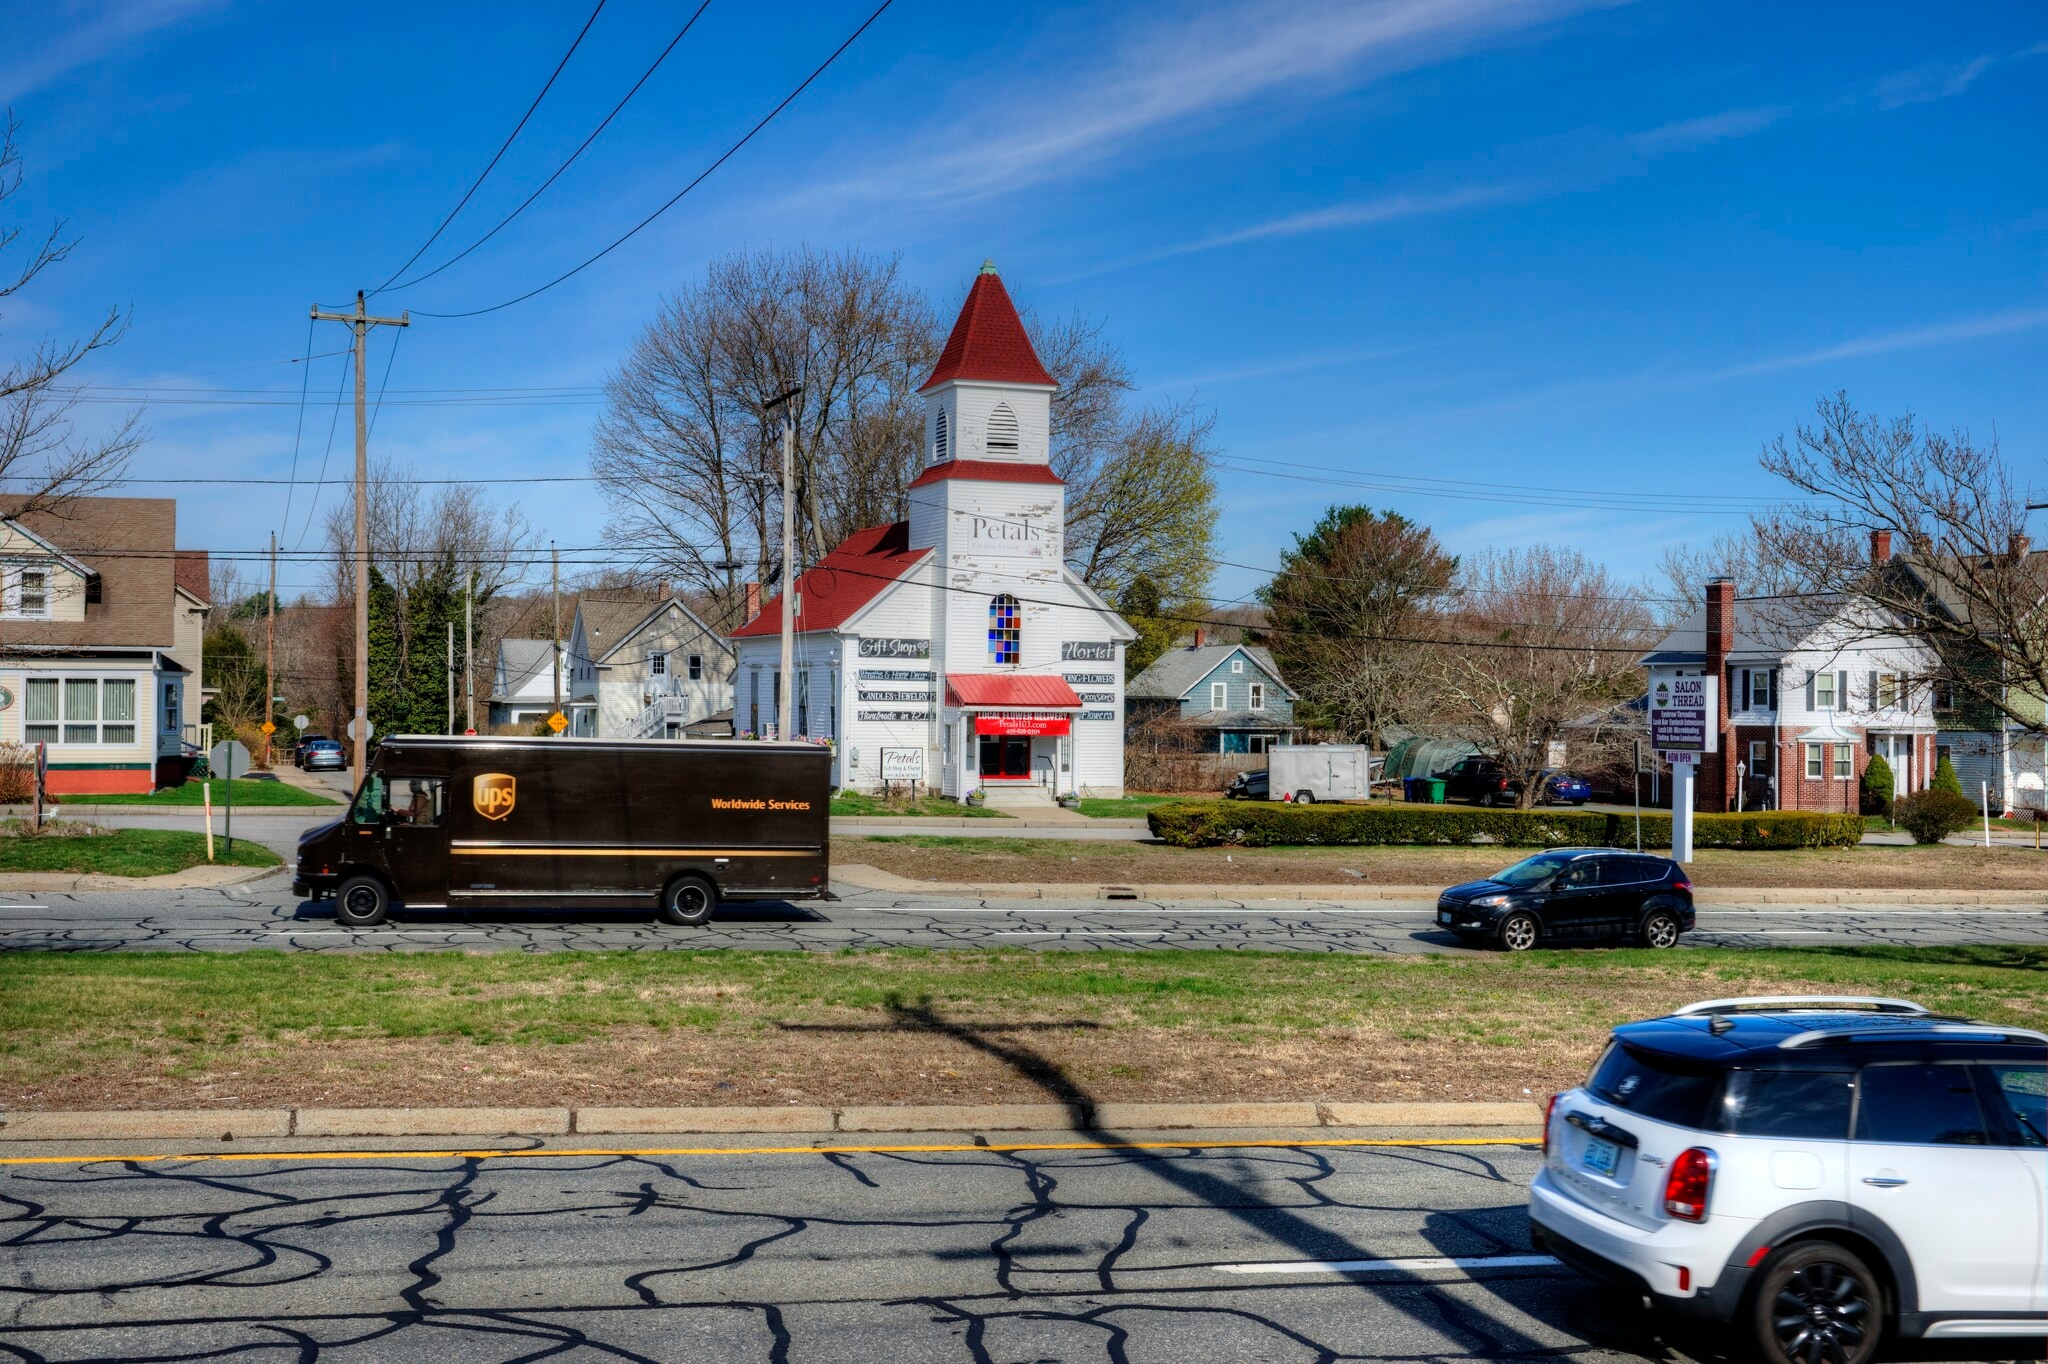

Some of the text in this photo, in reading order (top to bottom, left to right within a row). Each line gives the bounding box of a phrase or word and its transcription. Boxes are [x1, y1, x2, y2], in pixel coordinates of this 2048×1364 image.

[972, 518, 1040, 540] Petals
[860, 639, 916, 656] Gift Shop
[1062, 641, 1114, 659] Florist
[892, 671, 908, 679] Home
[910, 672, 928, 680] Decor
[1083, 674, 1115, 683] FLOWERS
[1675, 681, 1702, 693] SALON
[1672, 695, 1704, 707] THREAD
[859, 711, 896, 720] Handmade
[901, 711, 908, 720] in
[978, 711, 1067, 720] LOCAL FLOWER DELIVERY
[1081, 711, 1113, 720] Flowers
[1677, 711, 1696, 719] Threading
[999, 720, 1047, 728] Petals103.com
[884, 750, 920, 764] Petals
[1668, 753, 1691, 762] NOW OPEN
[477, 787, 513, 813] ups
[711, 799, 810, 810] Worldwide Services
